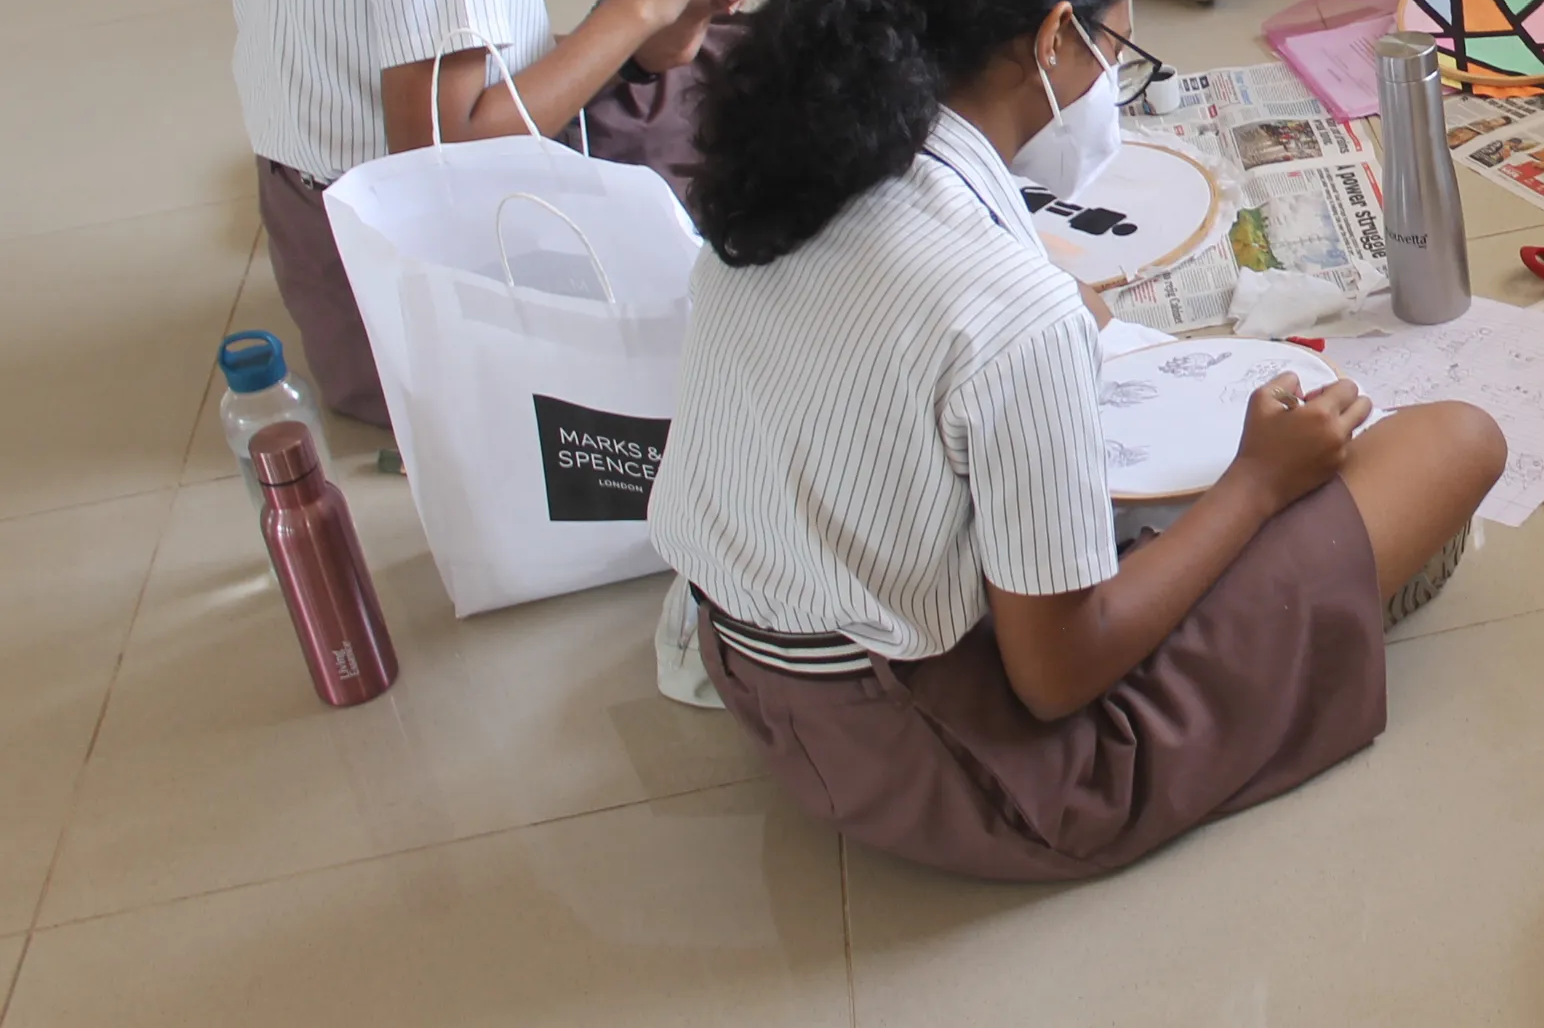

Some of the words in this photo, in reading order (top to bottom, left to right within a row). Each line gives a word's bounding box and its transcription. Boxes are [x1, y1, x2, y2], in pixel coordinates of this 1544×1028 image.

[1335, 172, 1368, 207] power
[1356, 209, 1388, 259] struggle
[558, 426, 642, 459] MARKS
[647, 446, 662, 462] &
[558, 450, 656, 480] SPENCE
[598, 478, 643, 493] LONDON
